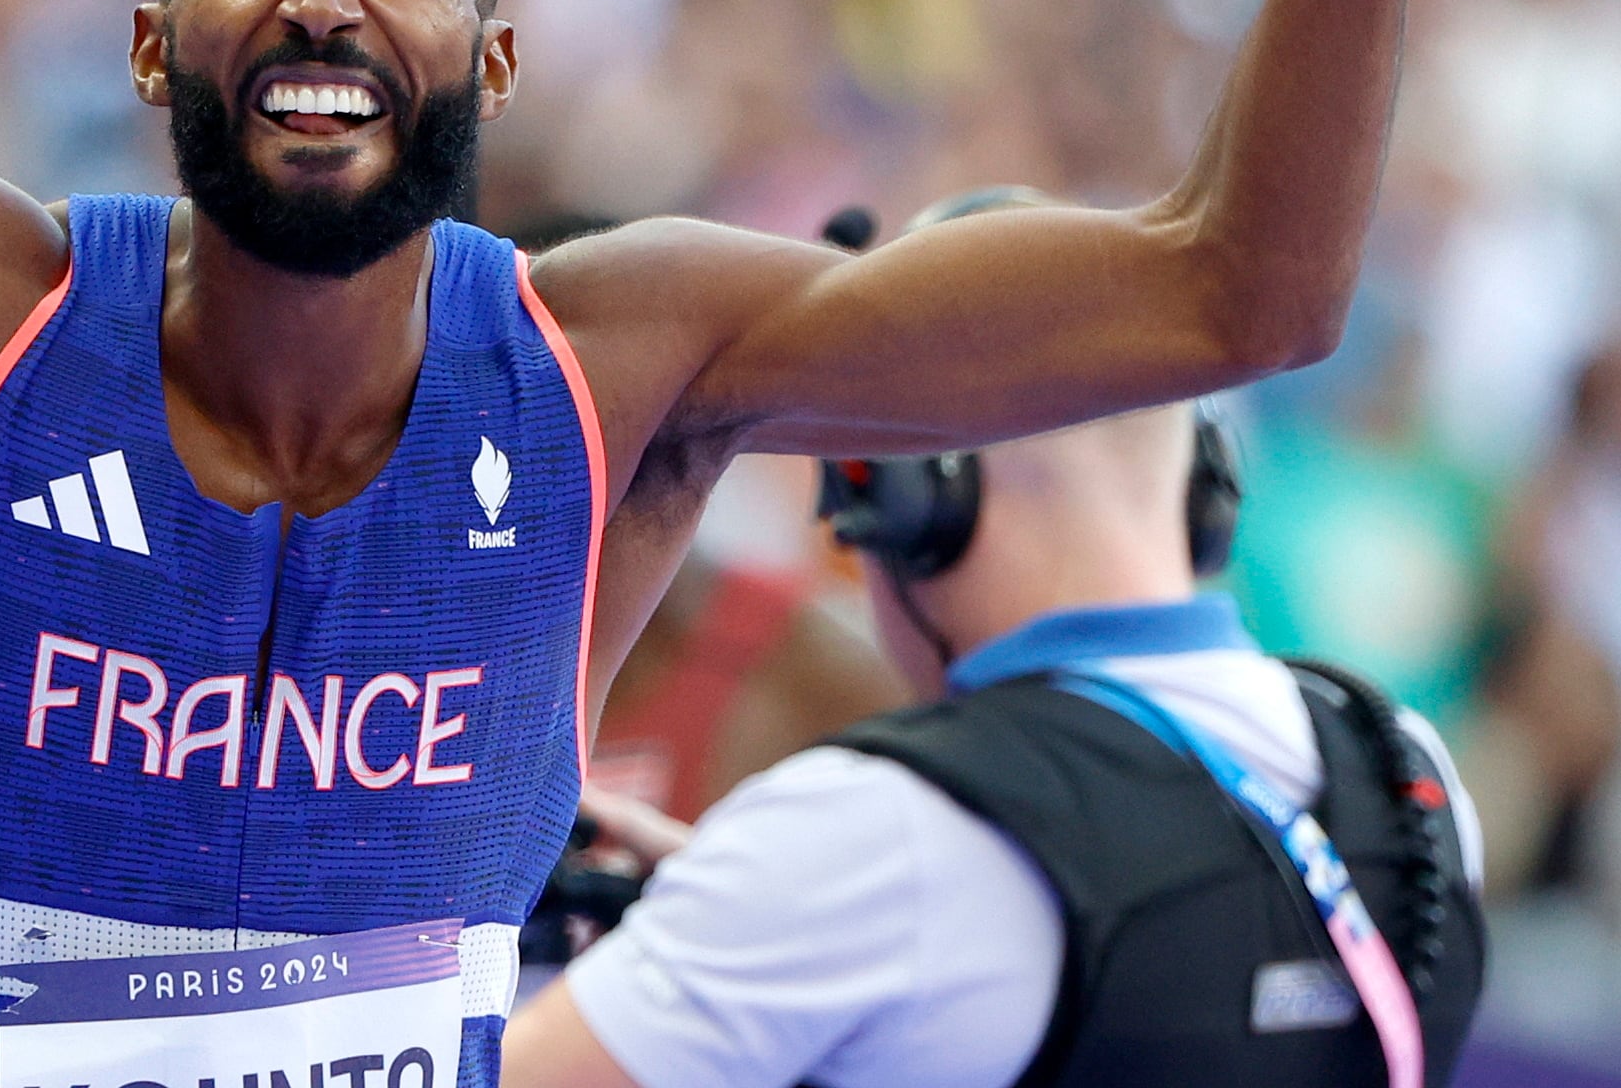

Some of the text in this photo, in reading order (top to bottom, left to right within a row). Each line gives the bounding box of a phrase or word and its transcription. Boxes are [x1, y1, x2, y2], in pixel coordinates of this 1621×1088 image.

[467, 526, 517, 549] FRANCE
[24, 630, 484, 791] FRANCE
[259, 951, 349, 991] 2024
